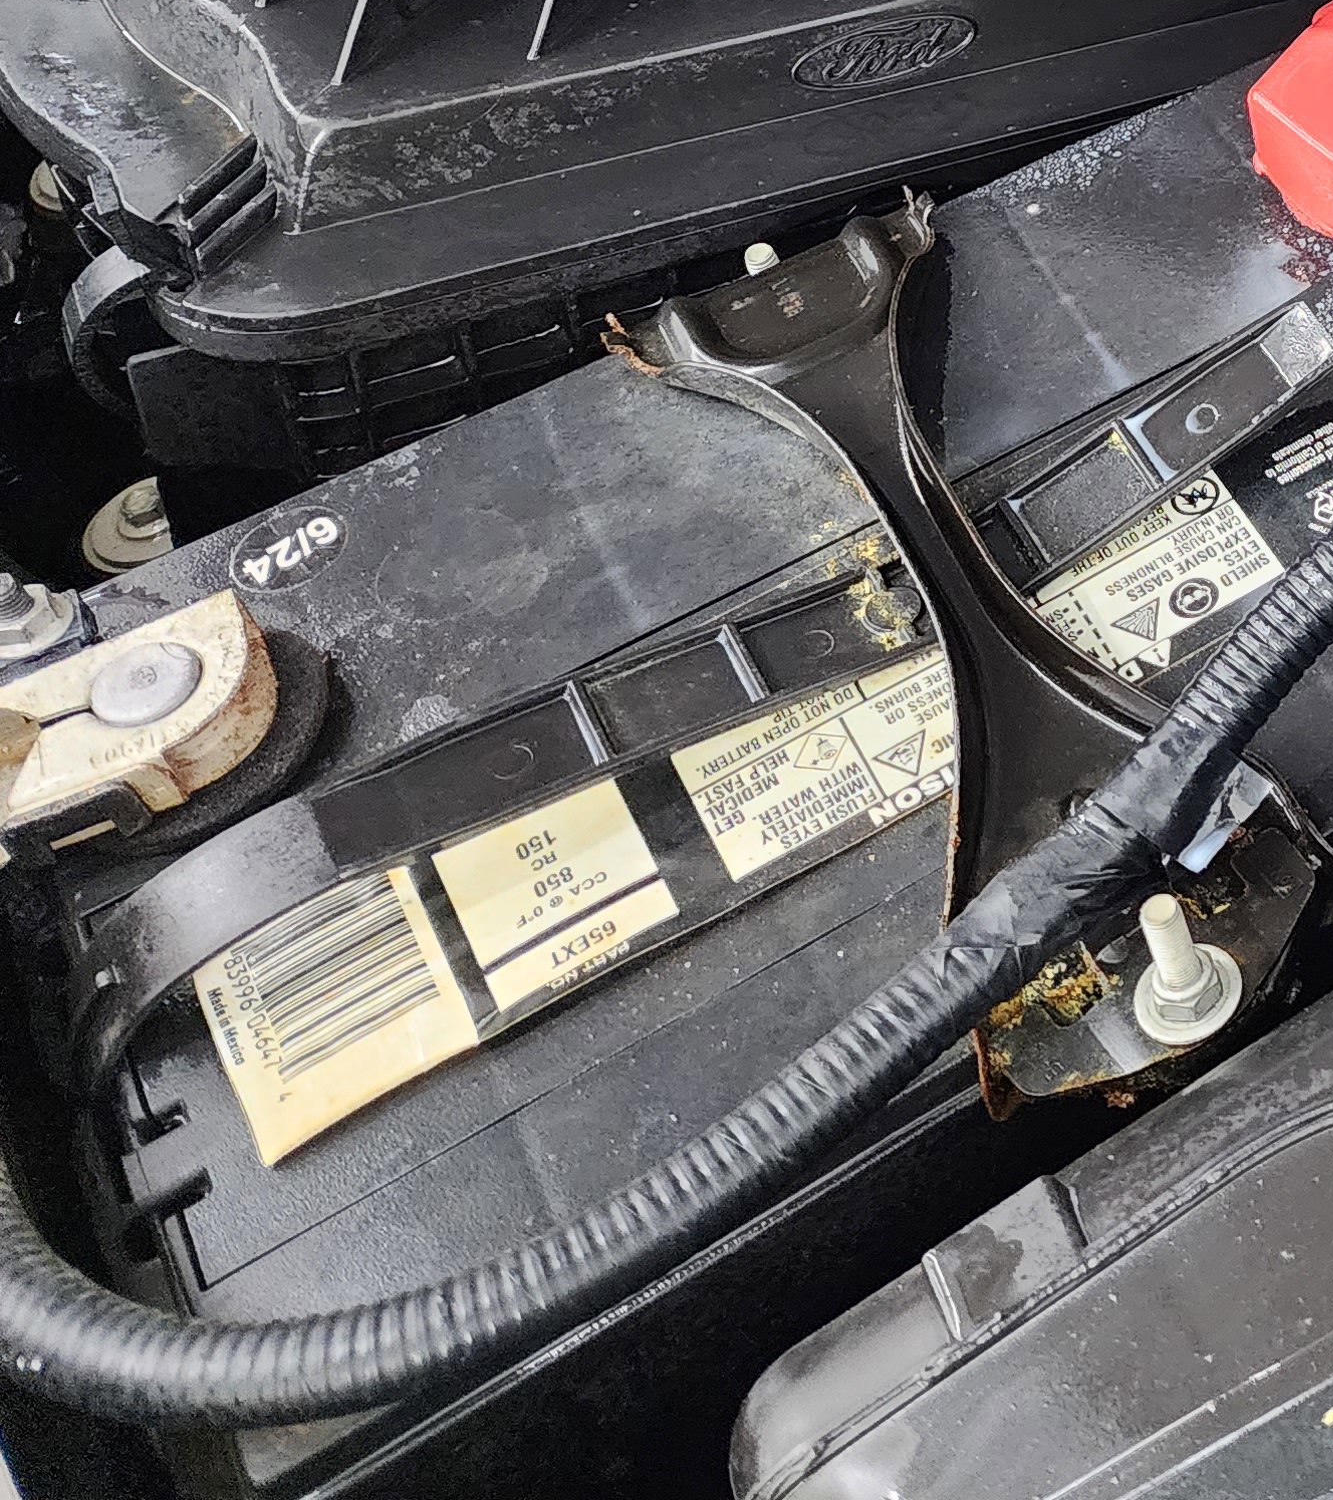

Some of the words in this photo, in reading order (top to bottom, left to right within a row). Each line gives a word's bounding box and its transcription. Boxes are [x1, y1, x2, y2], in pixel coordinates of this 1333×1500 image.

[820, 22, 951, 82] Ford
[1270, 432, 1315, 463] chemicals
[1274, 444, 1316, 474] California
[1263, 466, 1276, 479] to
[1275, 451, 1326, 486] accessories
[1143, 514, 1172, 537] KEEP
[1216, 505, 1234, 520] OR
[1218, 515, 1242, 533] CAN
[1116, 533, 1140, 551] OUT
[1166, 517, 1213, 546] INJURY.
[1179, 529, 1215, 553] CAUSE
[242, 516, 340, 585] 6/24
[1177, 527, 1251, 574] EXPLOSIVE
[1217, 542, 1261, 568] EYES.
[1071, 557, 1095, 577] THE
[1105, 553, 1174, 596] BLINDNESS
[1219, 553, 1270, 587] SHIELD
[1126, 571, 1174, 602] GASES
[923, 667, 950, 689] ERE
[833, 687, 855, 706] DO
[868, 680, 922, 714] BURNS.
[910, 682, 952, 709] DNESS
[804, 700, 832, 722] NOT
[884, 707, 907, 726] OR
[915, 701, 952, 727] AUSE
[763, 713, 802, 743] OPEN
[696, 741, 762, 781] BATTERY.
[750, 749, 791, 779] HELP
[817, 761, 863, 786] WITH
[697, 775, 746, 806] FAST.
[704, 772, 781, 821] MEDICAL
[828, 787, 877, 819] FLUSH
[868, 764, 957, 827] ISON
[751, 789, 818, 827] WATER.
[761, 774, 869, 845] IMMEDIATELY
[713, 811, 747, 837] GET
[780, 815, 824, 849] EYES
[515, 829, 558, 860] 150
[530, 850, 558, 872] RC
[533, 866, 575, 898] 850
[569, 871, 608, 897] CCA
[549, 895, 564, 909] @
[516, 905, 544, 930] 0°F
[551, 920, 617, 969] 65EXT
[582, 940, 631, 976] PART
[207, 986, 226, 1019] Made
[224, 955, 260, 1012] 83996
[246, 1012, 284, 1071] 04647
[218, 1014, 232, 1030] in
[223, 1026, 246, 1067] Mexico
